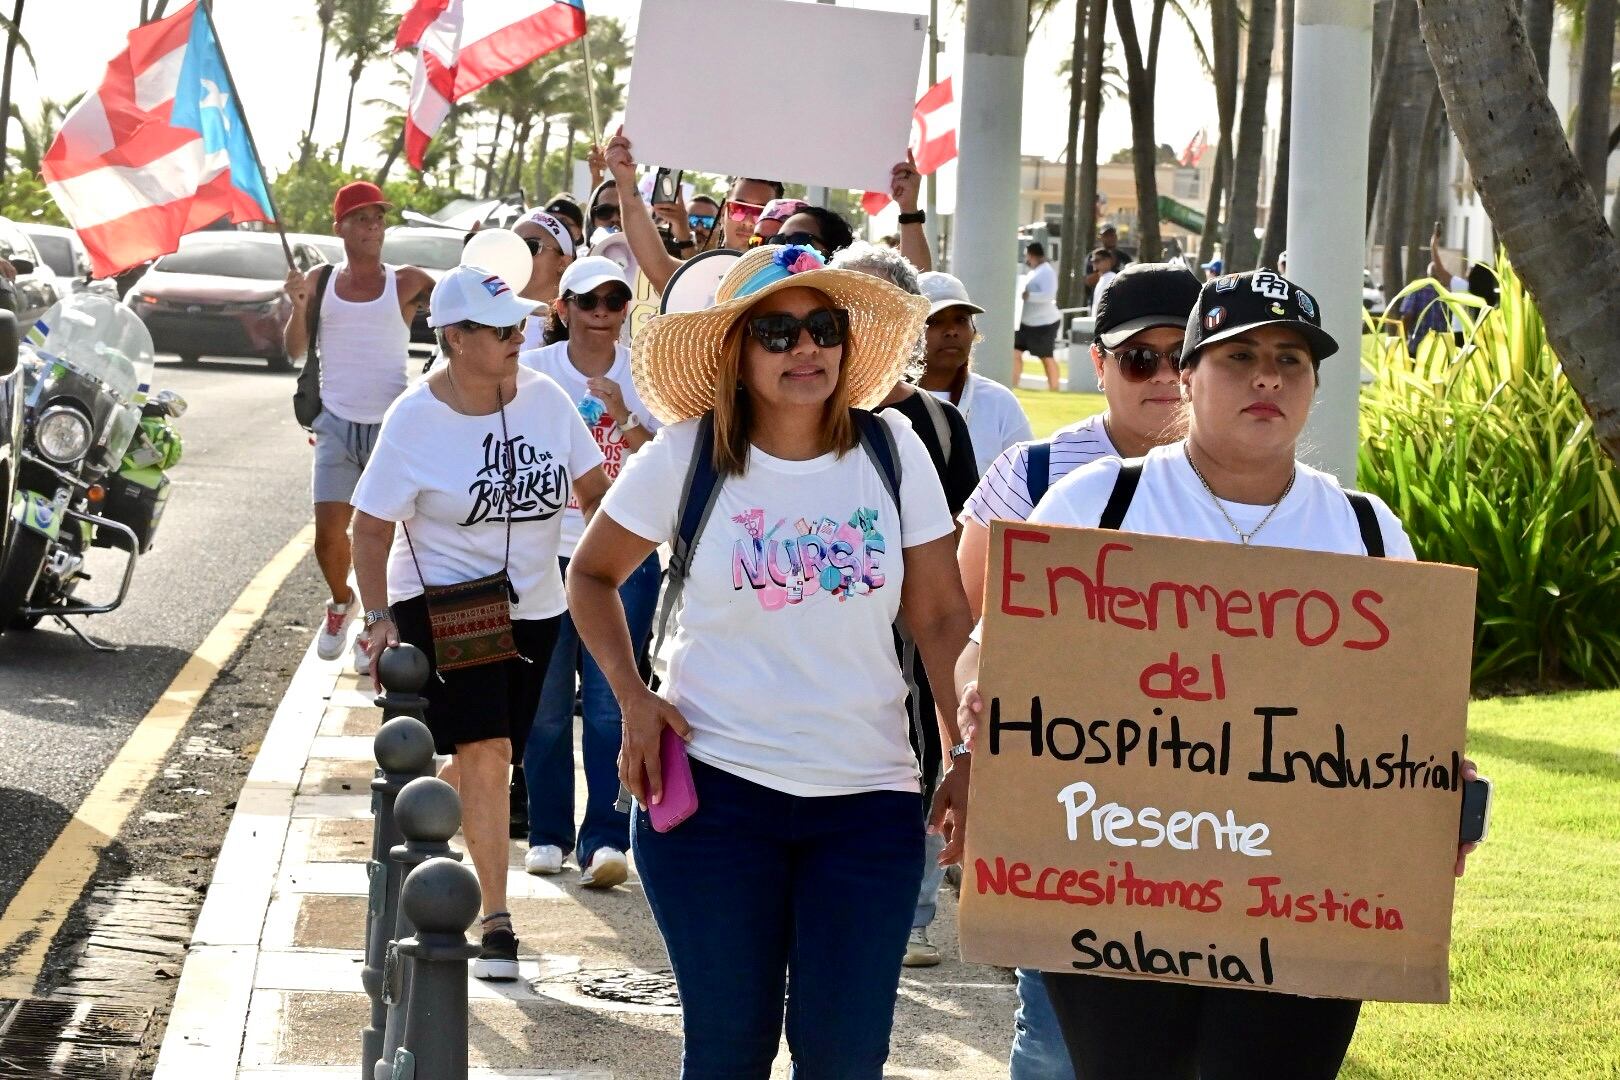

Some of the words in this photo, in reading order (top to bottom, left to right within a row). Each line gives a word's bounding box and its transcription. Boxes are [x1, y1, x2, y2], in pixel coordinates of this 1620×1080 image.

[732, 534, 886, 590] NURSE
[1002, 528, 1390, 650] Enfermeros
[1139, 652, 1226, 701] del
[989, 695, 1232, 776] Hospital
[1247, 706, 1460, 792] Industrial
[1057, 781, 1273, 857] Presente
[975, 856, 1224, 912] Necesitamos
[1246, 875, 1404, 930] Justicia
[1071, 928, 1275, 985] Salarial
